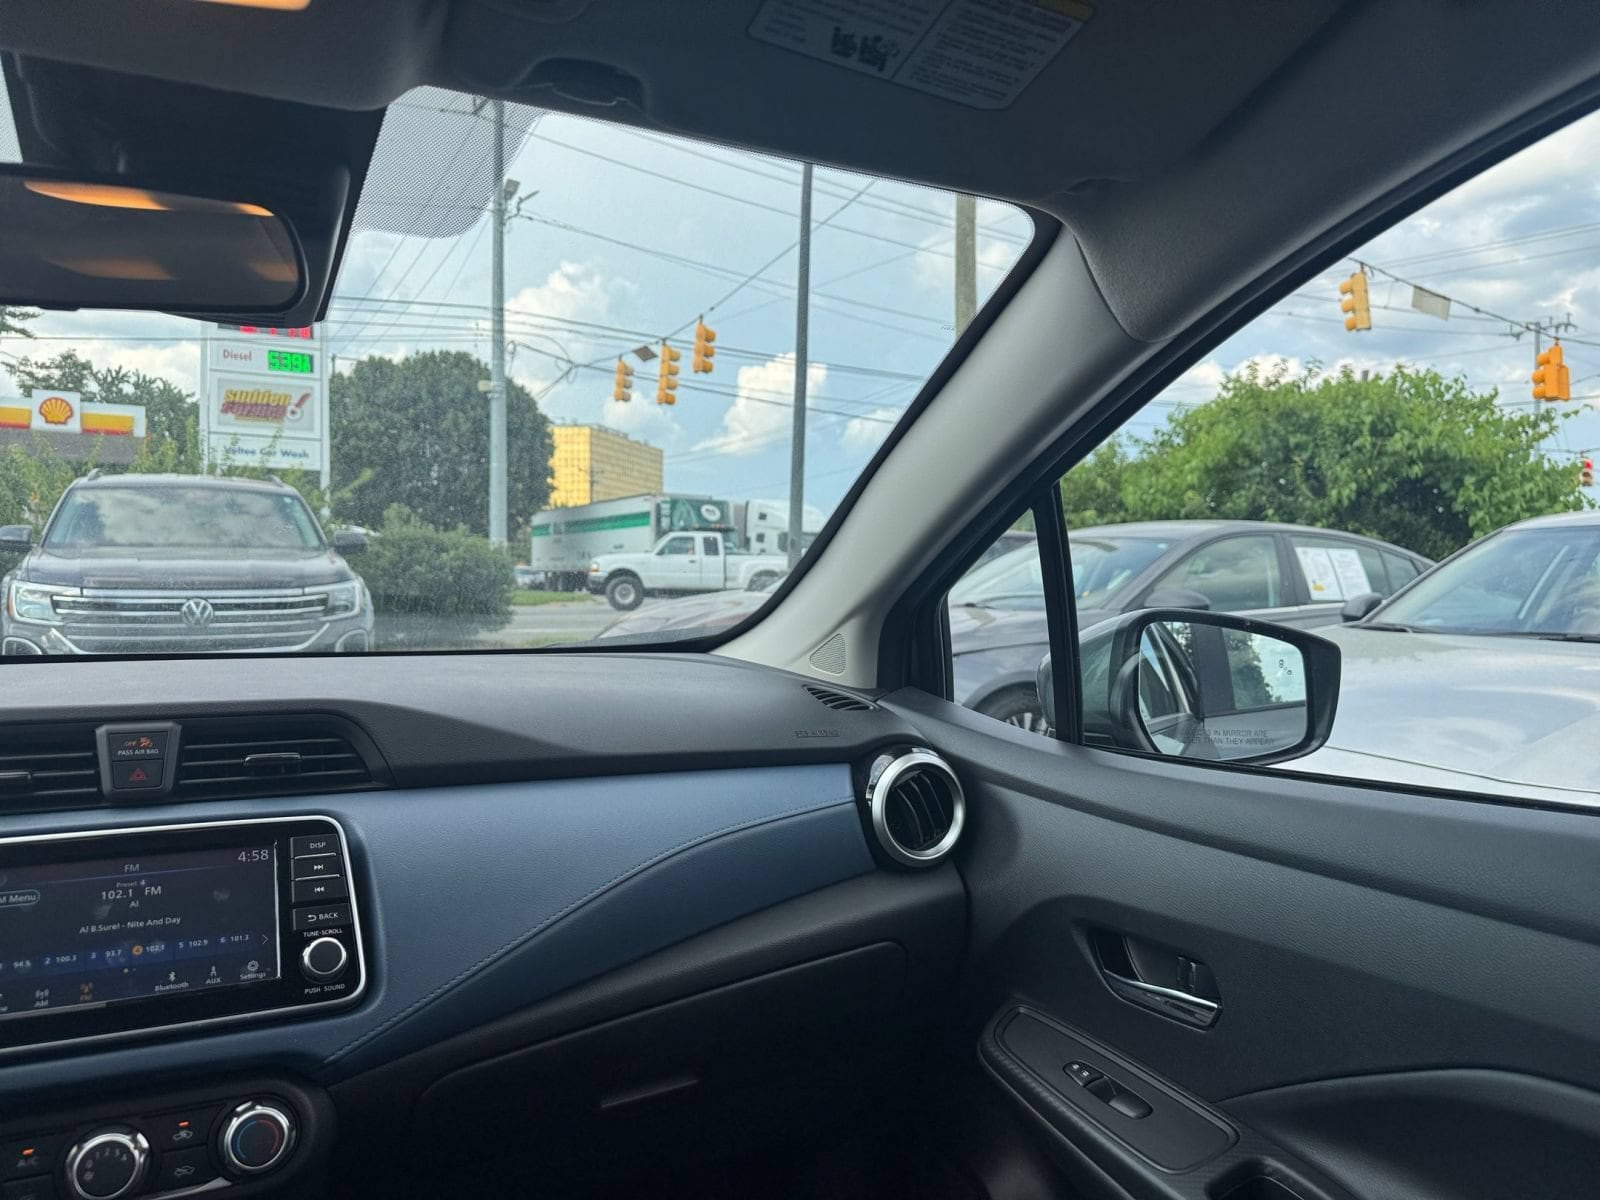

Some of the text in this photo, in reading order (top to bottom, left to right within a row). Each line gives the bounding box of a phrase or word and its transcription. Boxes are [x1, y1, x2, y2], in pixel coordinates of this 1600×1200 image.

[222, 349, 252, 361] Diesel
[1222, 729, 1252, 737] MIRROR
[1254, 729, 1268, 737] ARE
[1225, 737, 1243, 745] THEY
[309, 841, 327, 849] DISP
[238, 849, 269, 862] 4:58
[124, 863, 140, 873] FM
[101, 885, 162, 900] 102.1 FM
[8, 893, 37, 904] Menu
[318, 911, 339, 920] BACK
[127, 919, 145, 928] Nite
[146, 917, 164, 926] And
[165, 916, 181, 925] Day
[230, 934, 250, 942] 101.3
[145, 944, 165, 953] 102.1
[188, 938, 209, 949] 102.9
[90, 951, 97, 960] 3
[205, 976, 222, 985] AUX
[240, 971, 267, 981] Settings
[154, 981, 189, 992] Bluetooth
[304, 983, 346, 995] PUSH SOUND
